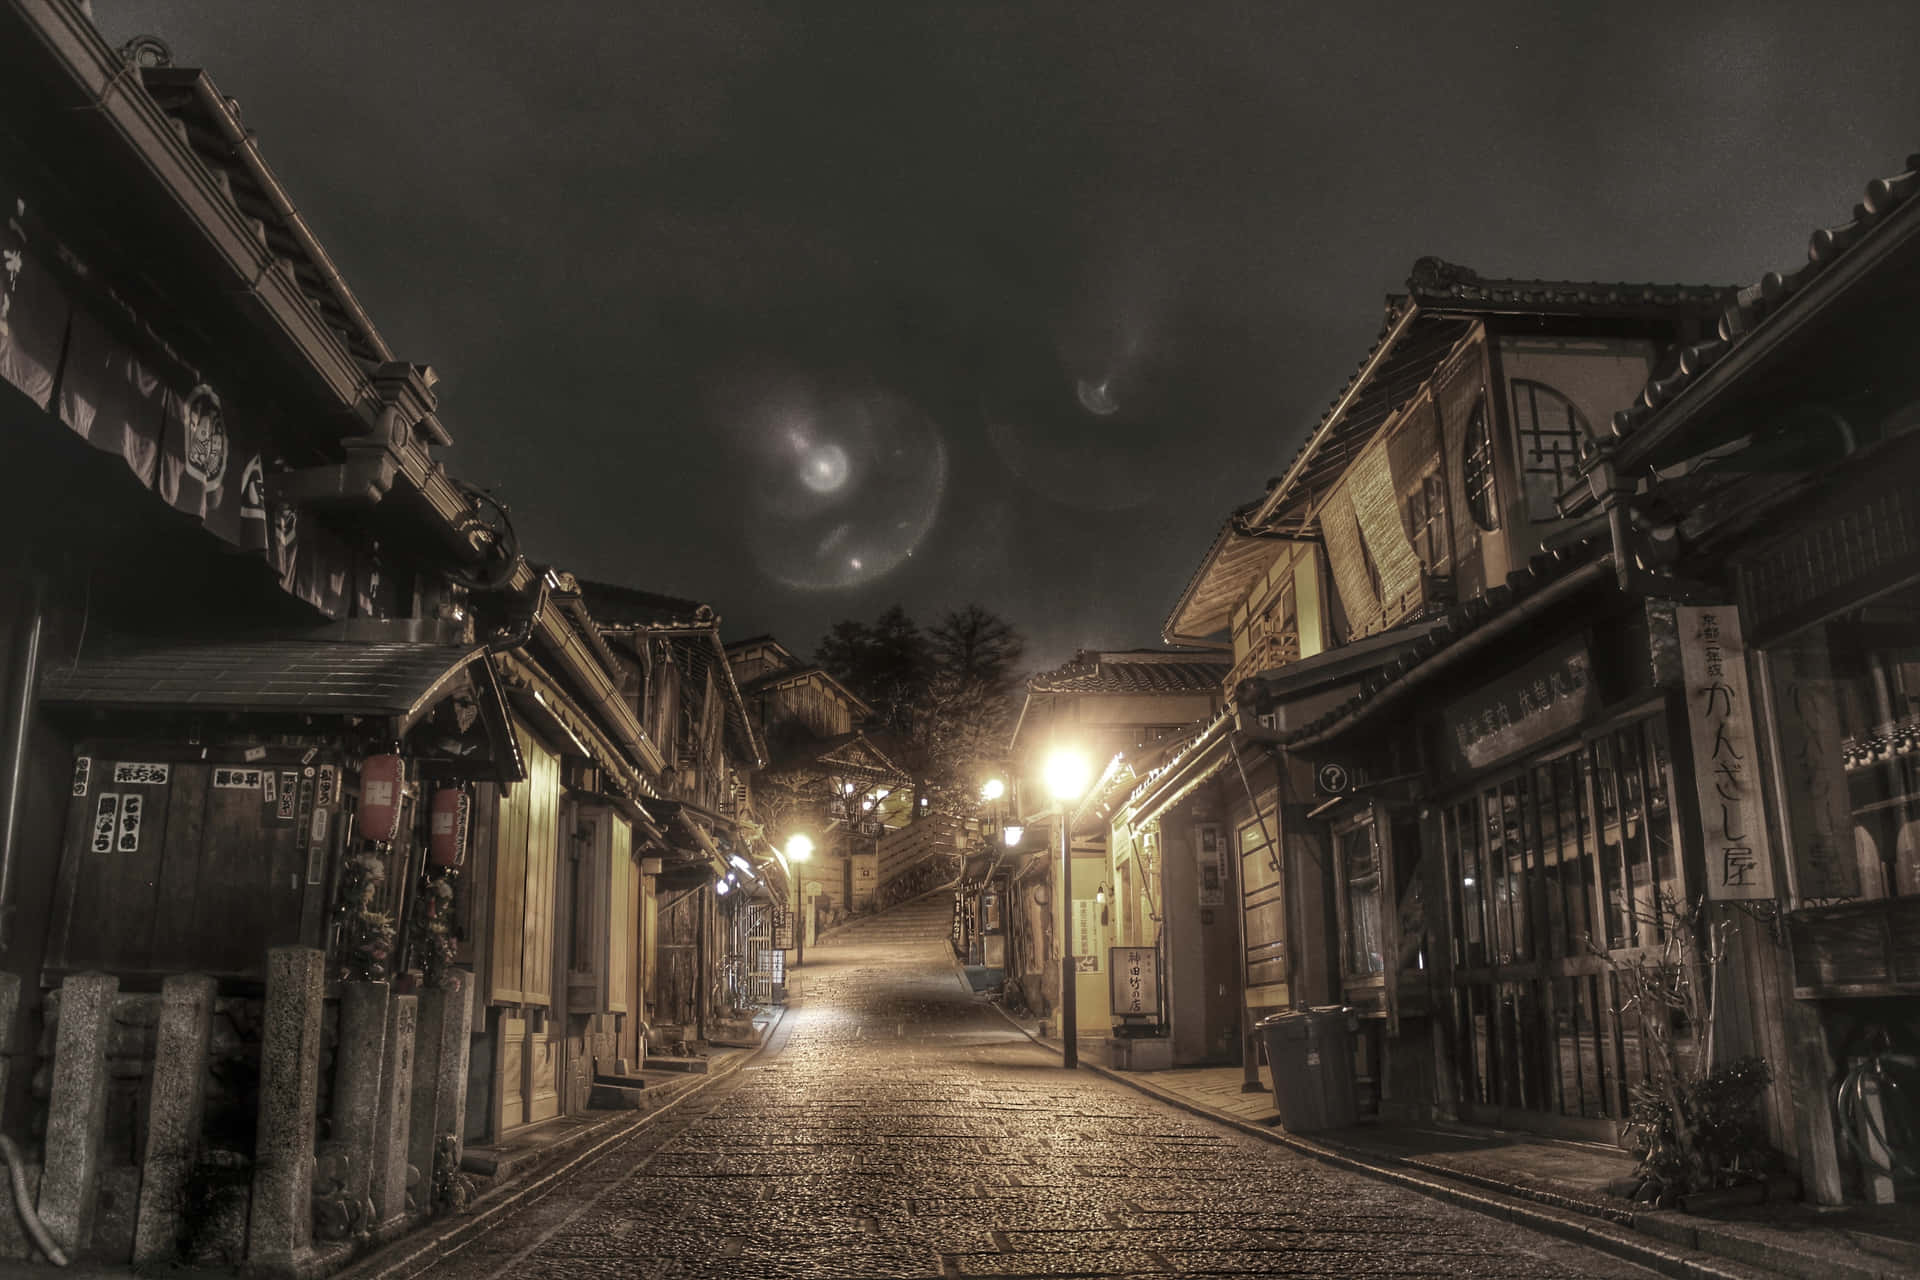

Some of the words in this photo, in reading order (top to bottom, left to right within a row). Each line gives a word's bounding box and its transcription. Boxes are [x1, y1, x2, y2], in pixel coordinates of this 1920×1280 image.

[1703, 681, 1757, 887] かんざし屋
